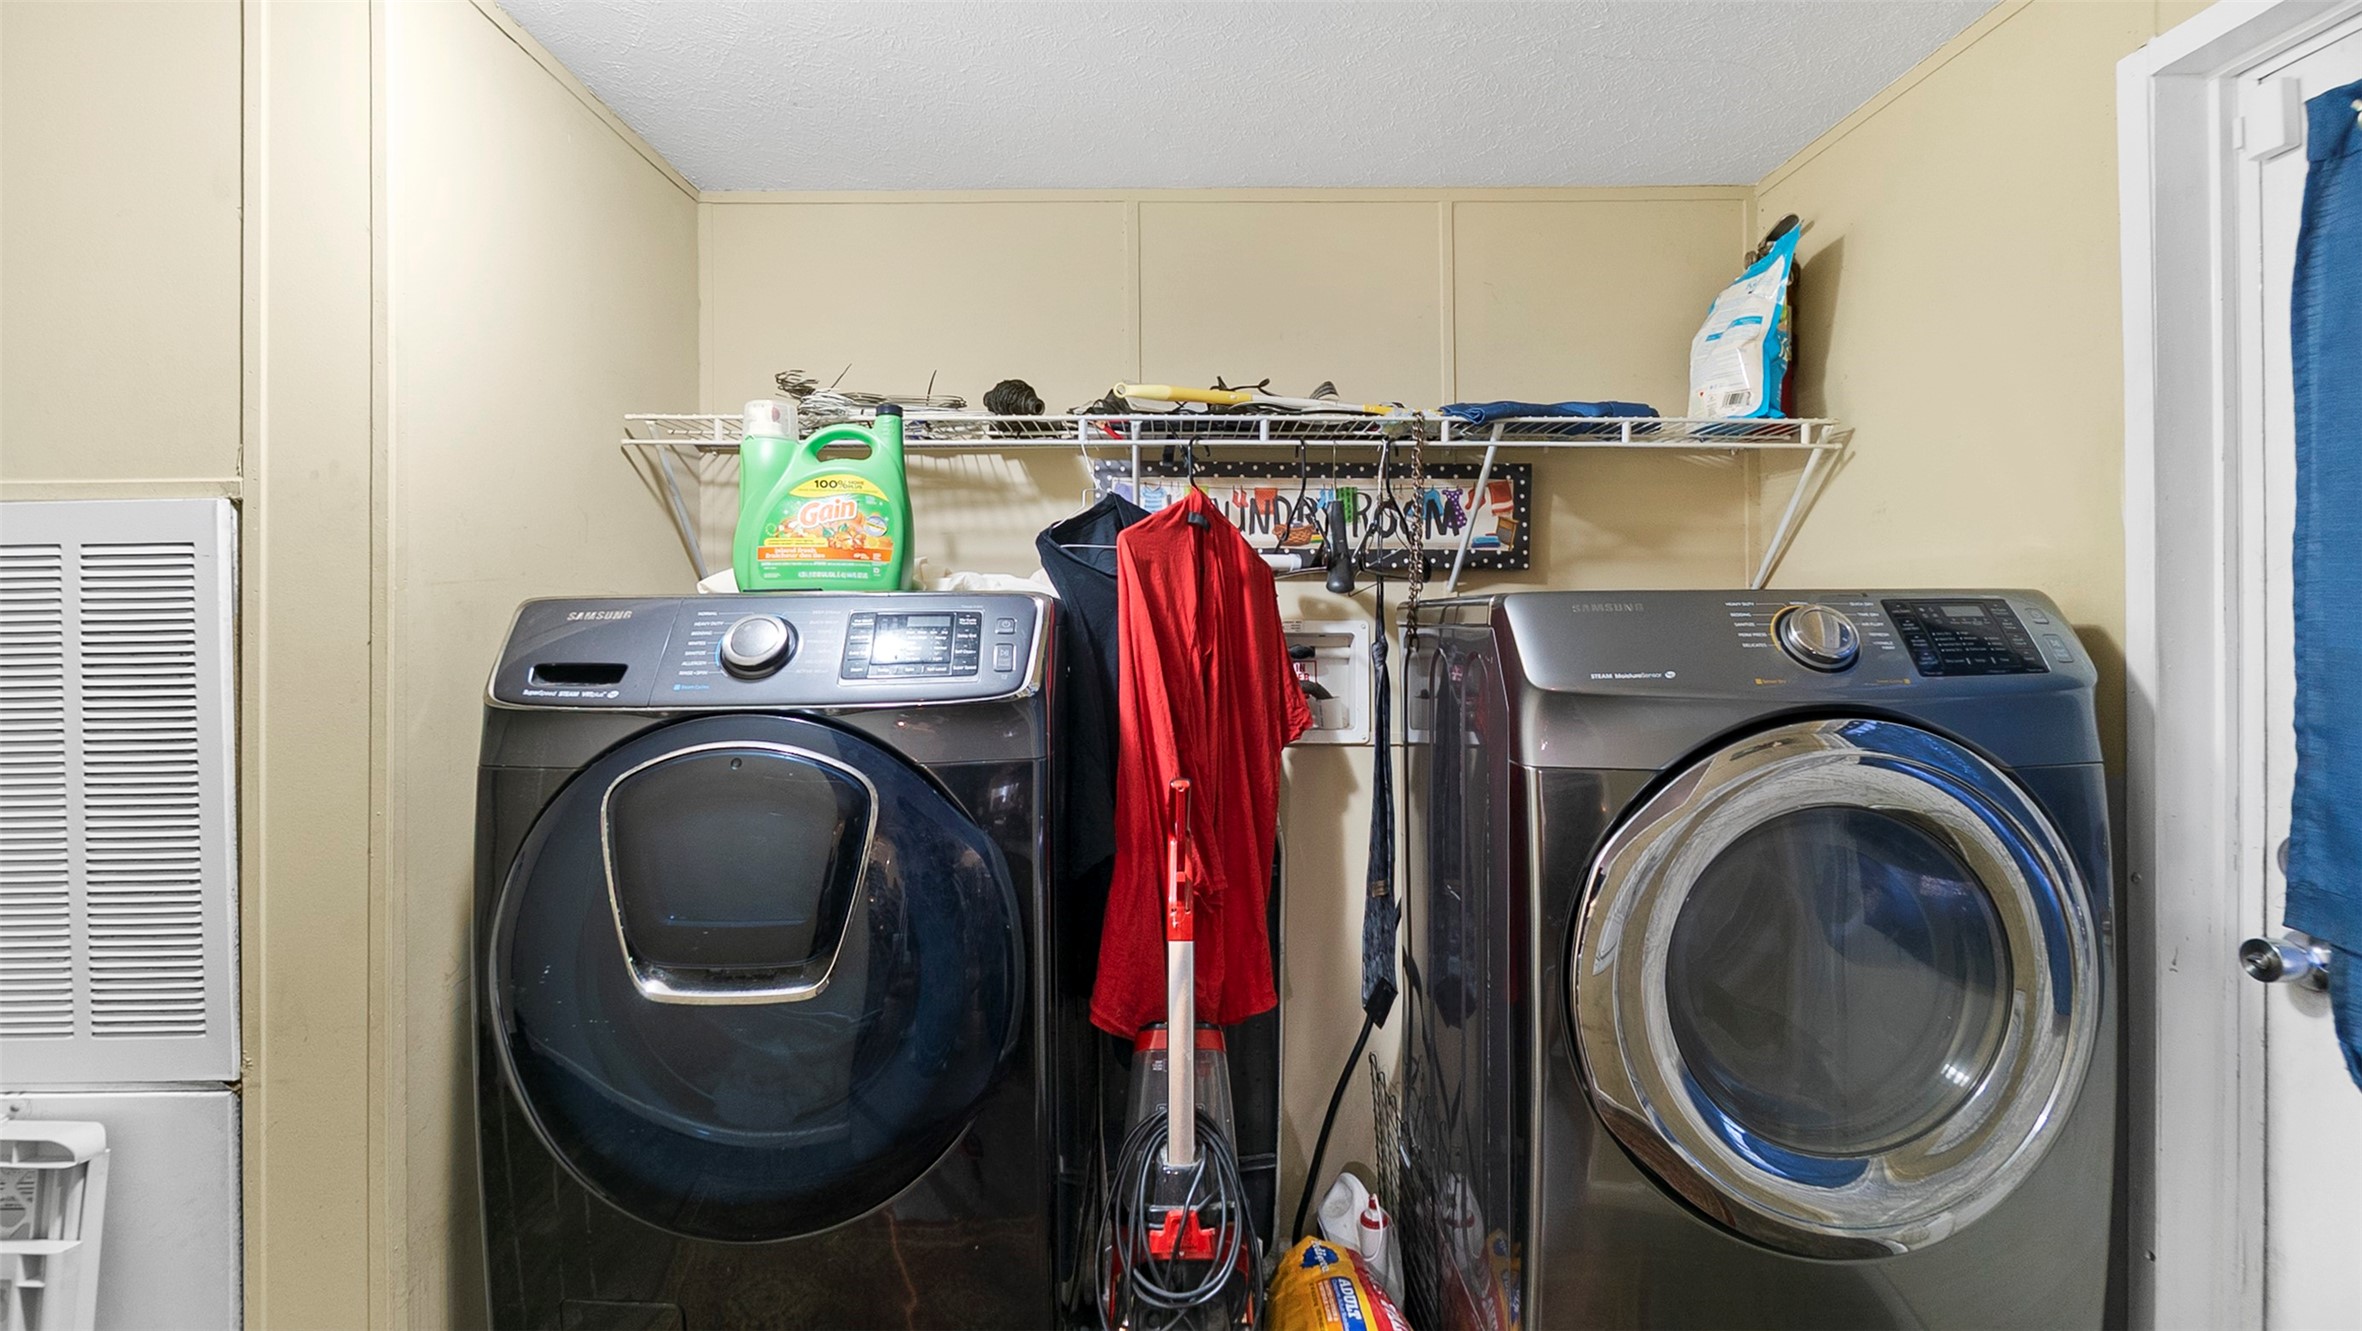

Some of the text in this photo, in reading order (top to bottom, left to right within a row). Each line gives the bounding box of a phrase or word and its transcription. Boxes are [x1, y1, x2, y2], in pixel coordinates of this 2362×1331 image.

[799, 498, 857, 527] Gain
[567, 610, 633, 621] SAMSUNG
[1572, 603, 1644, 613] SAMSUNG
[1338, 1278, 1362, 1320] ADULT
